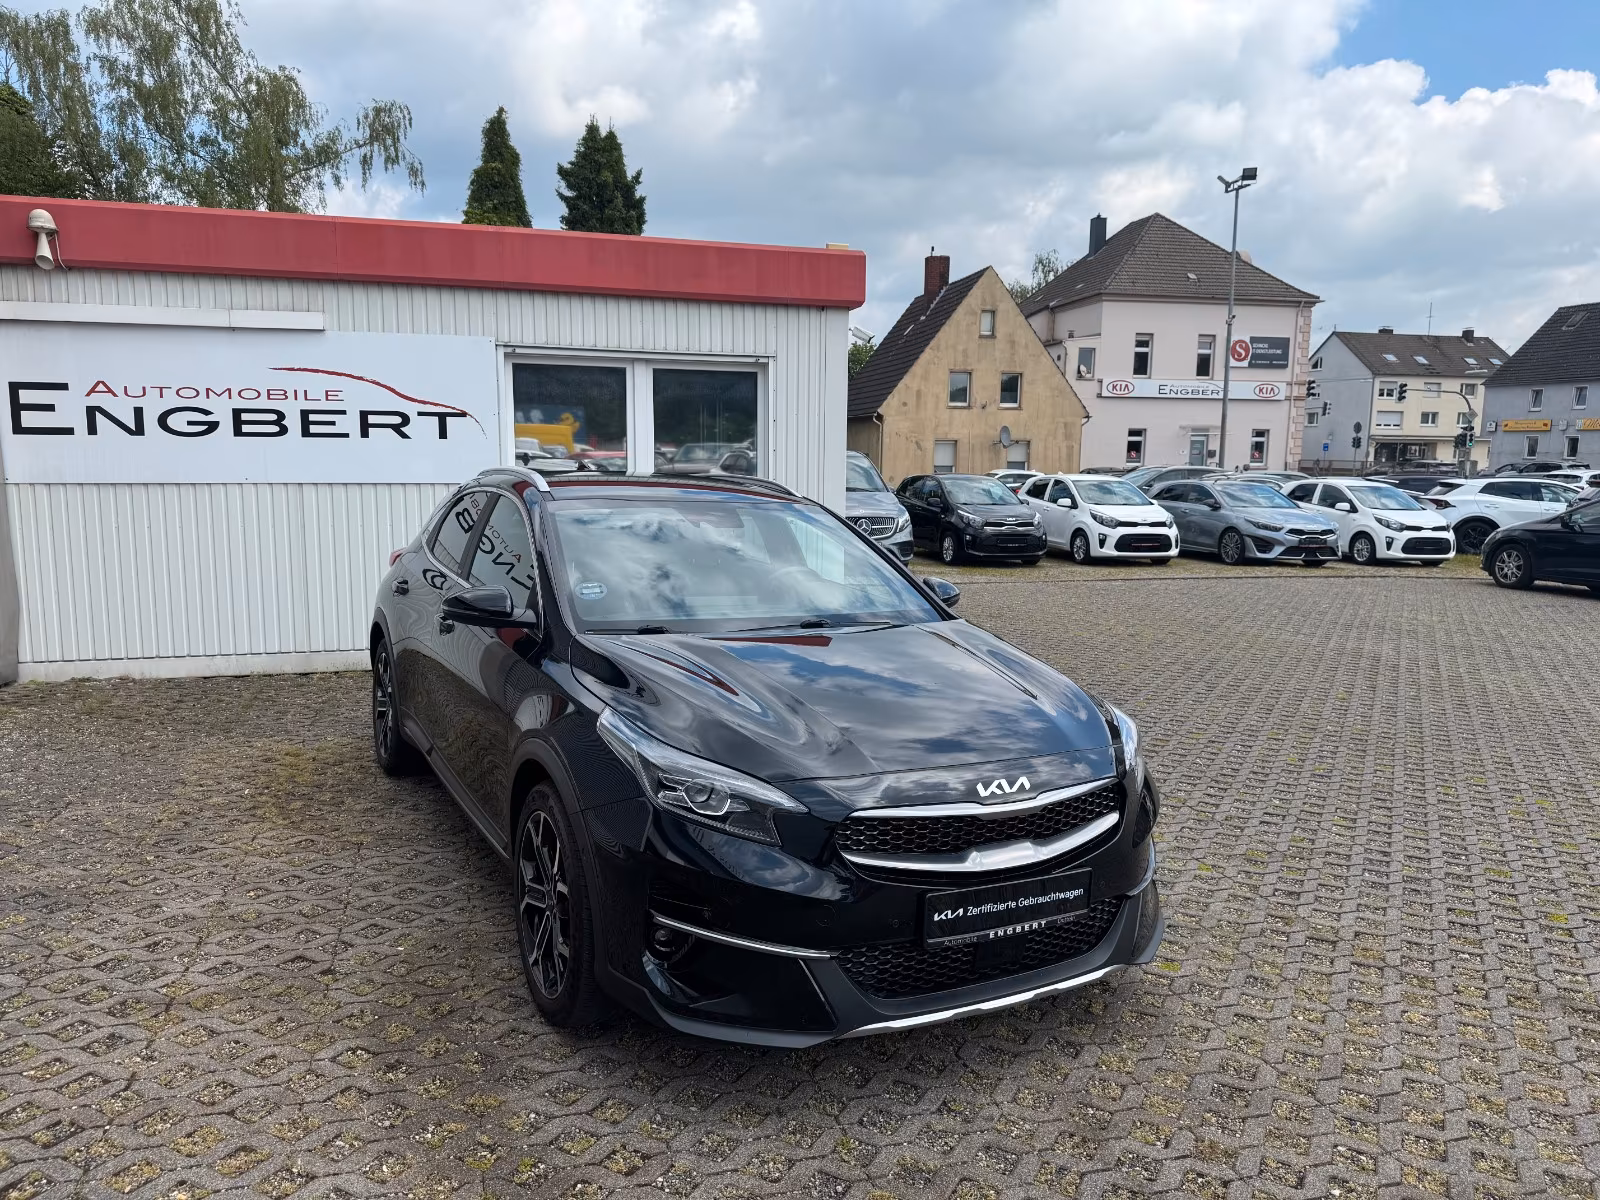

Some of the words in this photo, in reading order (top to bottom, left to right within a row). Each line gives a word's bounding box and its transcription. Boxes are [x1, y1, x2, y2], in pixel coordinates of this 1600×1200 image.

[84, 380, 345, 402] AUTOMOBILE
[1111, 383, 1130, 392] KIA
[1258, 386, 1276, 395] KIA
[8, 381, 468, 440] ENGBERT
[976, 776, 1031, 797] KIA
[933, 908, 964, 921] KIA
[967, 900, 1017, 916] Zertifizierte
[1018, 888, 1084, 907] Gebrauchtwagen
[989, 920, 1047, 939] ENGBERT
